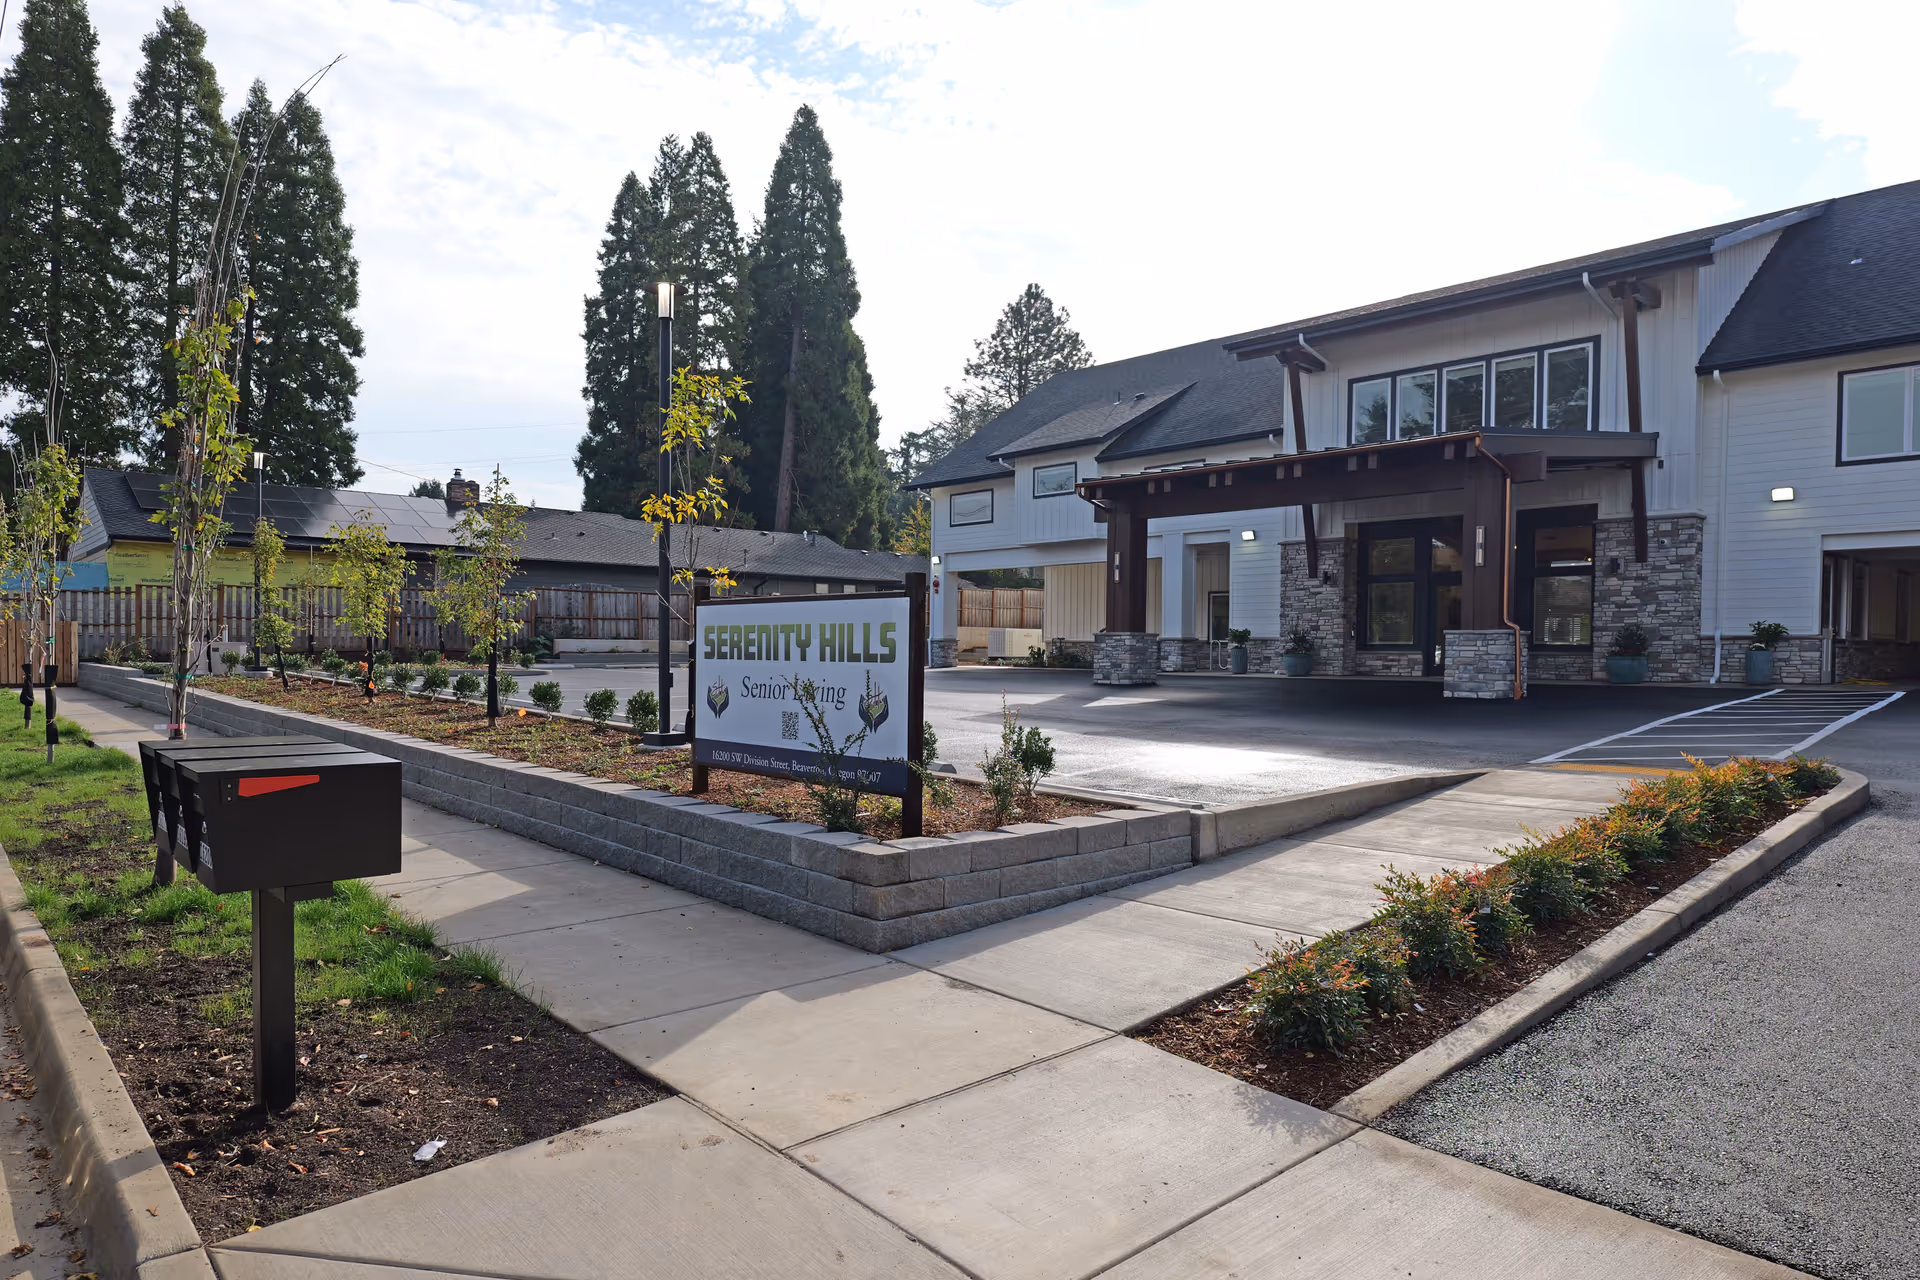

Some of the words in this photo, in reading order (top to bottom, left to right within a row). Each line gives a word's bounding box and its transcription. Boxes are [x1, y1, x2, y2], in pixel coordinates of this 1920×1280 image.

[704, 624, 811, 661] SERENITY
[819, 622, 896, 664] HILLS
[741, 675, 790, 701] Senior
[793, 677, 847, 711] Liing
[712, 750, 730, 762] 16200
[731, 752, 743, 763] SW
[743, 754, 769, 767] Division
[770, 757, 791, 771] Street,
